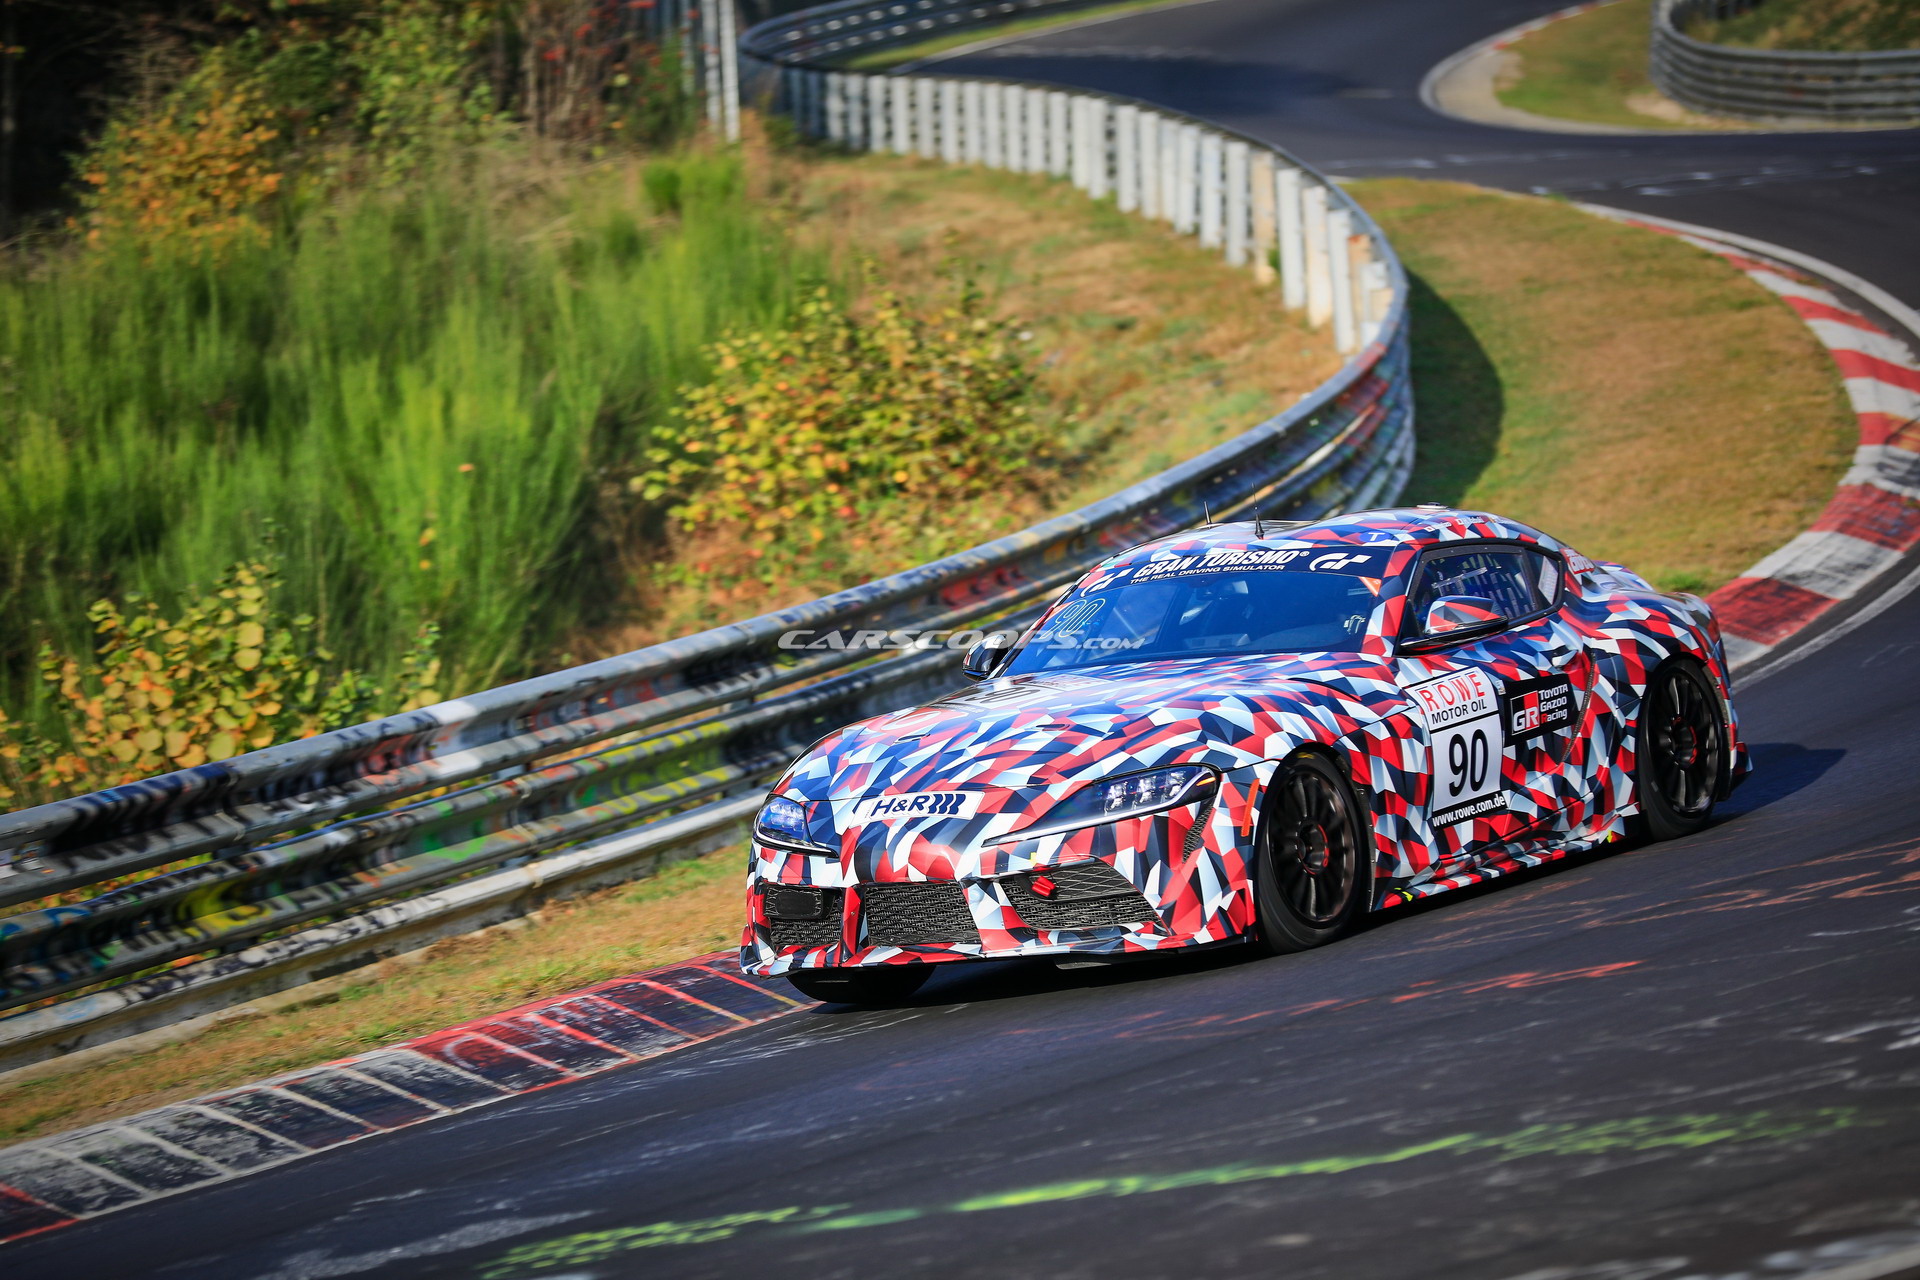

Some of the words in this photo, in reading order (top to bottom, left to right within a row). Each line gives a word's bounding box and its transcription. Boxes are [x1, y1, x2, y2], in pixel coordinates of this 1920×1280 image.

[1130, 577, 1149, 585] THE
[1150, 572, 1176, 580] REAL
[1178, 566, 1220, 576] DRIVING
[1222, 564, 1286, 572] SIMULATOR
[1133, 556, 1199, 579] GRAN
[1040, 598, 1106, 639] 90
[1418, 673, 1486, 712] ROWE
[1539, 683, 1569, 701] TOYOTA
[1540, 696, 1567, 712] GAZOO
[1431, 704, 1469, 725] MOTOR
[1471, 699, 1488, 713] OIL
[1513, 706, 1539, 732] GR
[1541, 708, 1568, 724] Racing
[1448, 728, 1489, 797] 90
[870, 795, 931, 817] H&R
[1432, 794, 1506, 828] www.rowe.com.de
